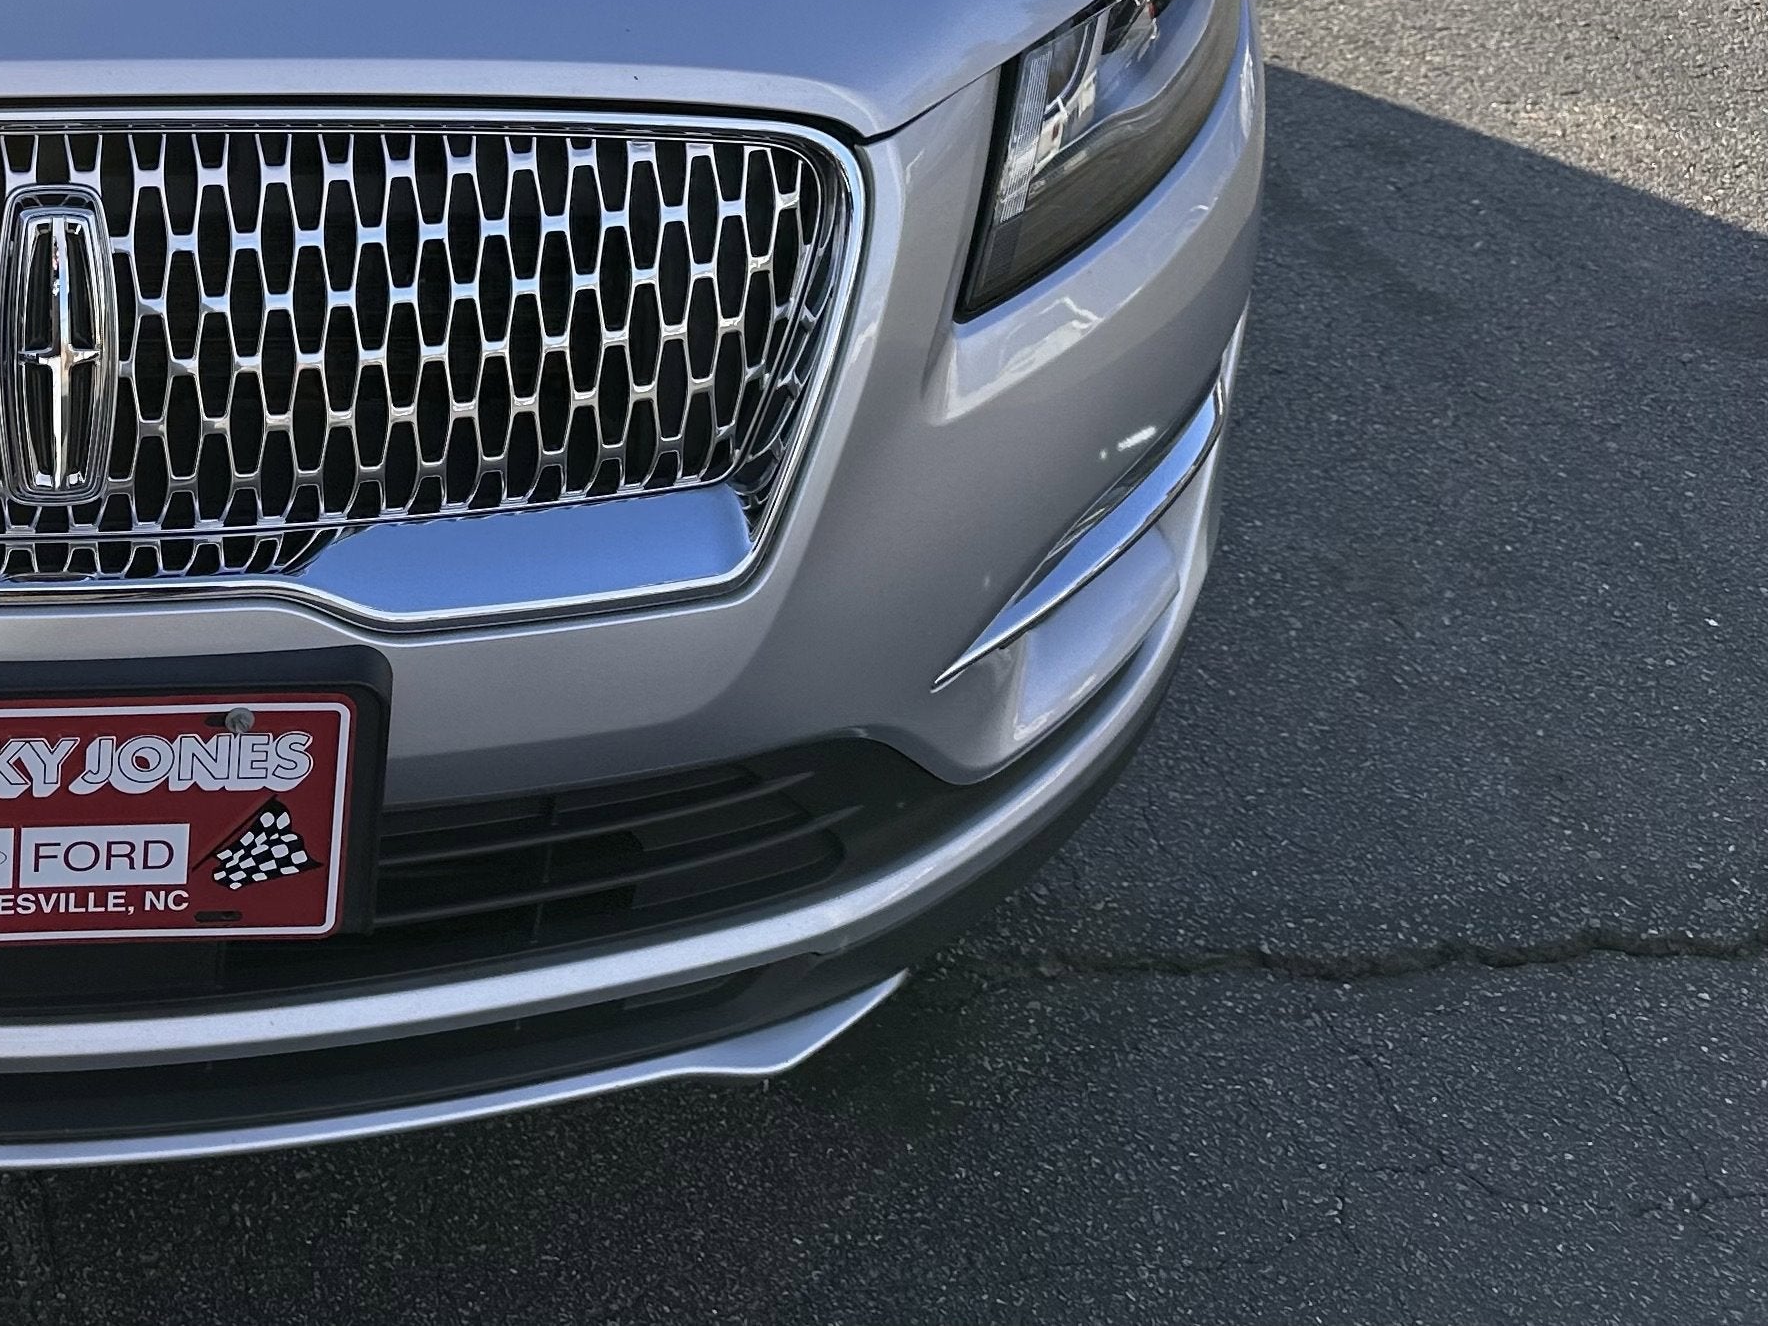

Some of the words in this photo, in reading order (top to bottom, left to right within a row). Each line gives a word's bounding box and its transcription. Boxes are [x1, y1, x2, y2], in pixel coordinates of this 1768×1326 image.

[69, 730, 314, 795] JONES
[33, 839, 175, 873] FORD
[143, 889, 189, 912] NC
